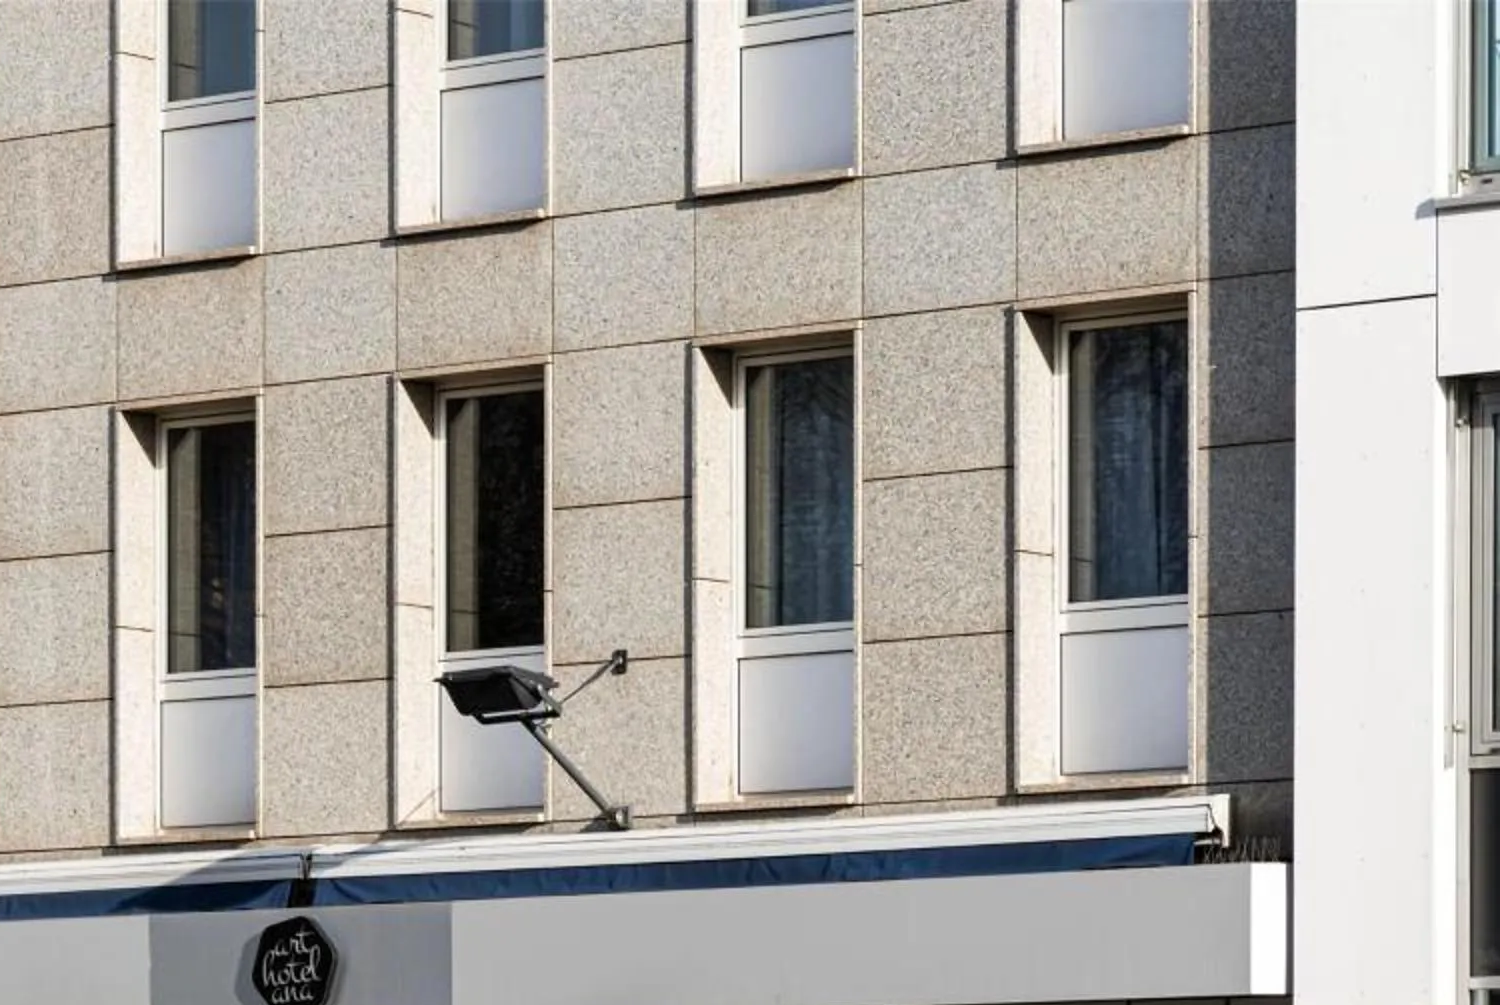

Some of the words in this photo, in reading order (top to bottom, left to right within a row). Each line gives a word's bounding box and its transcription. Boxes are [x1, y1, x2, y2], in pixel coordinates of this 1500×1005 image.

[274, 926, 315, 957] art
[262, 944, 321, 987] hotel
[271, 984, 315, 1004] ana
